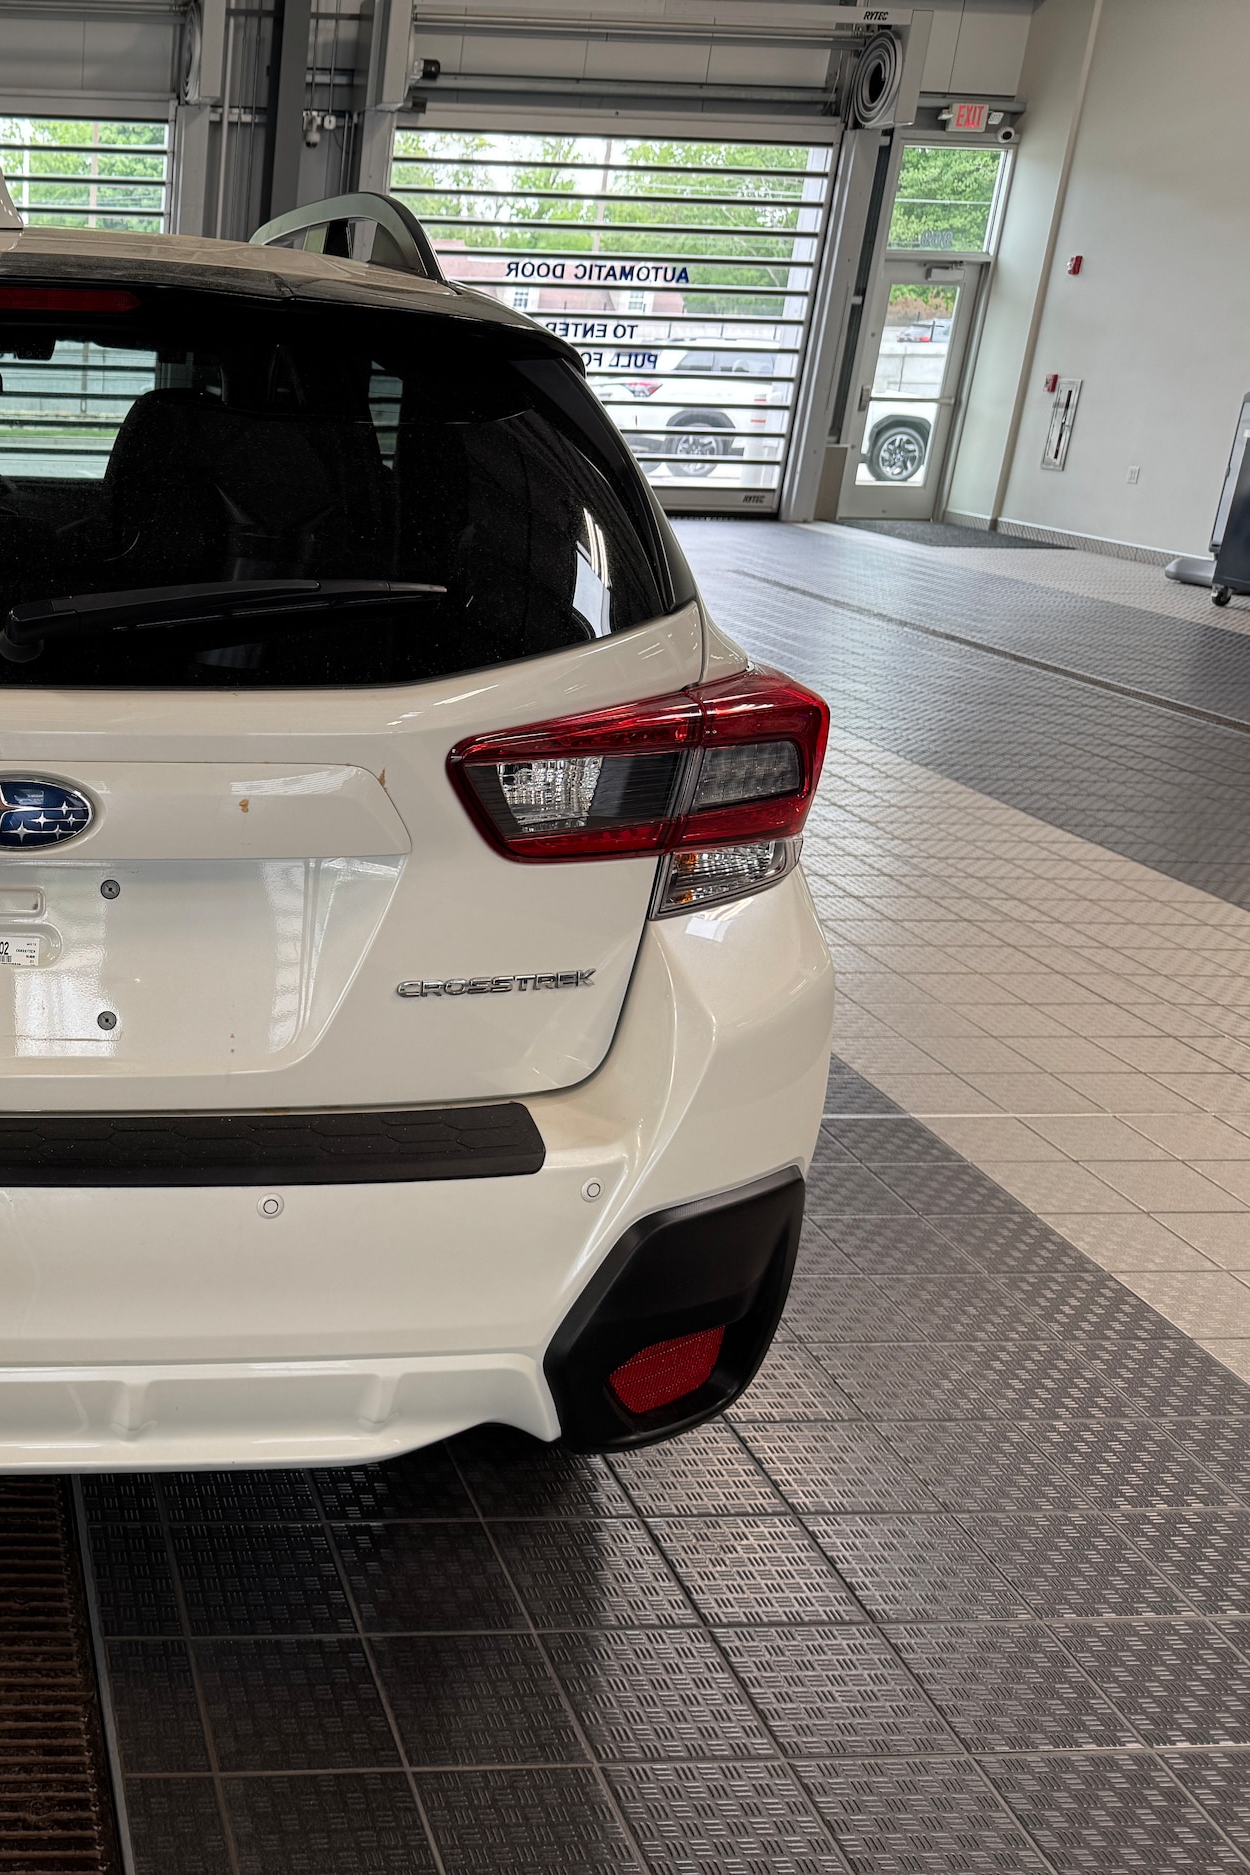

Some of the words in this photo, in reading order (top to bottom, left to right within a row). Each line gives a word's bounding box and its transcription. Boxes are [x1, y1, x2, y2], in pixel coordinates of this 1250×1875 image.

[863, 11, 889, 21] RYTEC
[955, 104, 985, 129] EXIT
[396, 967, 597, 998] CROSSTREK
